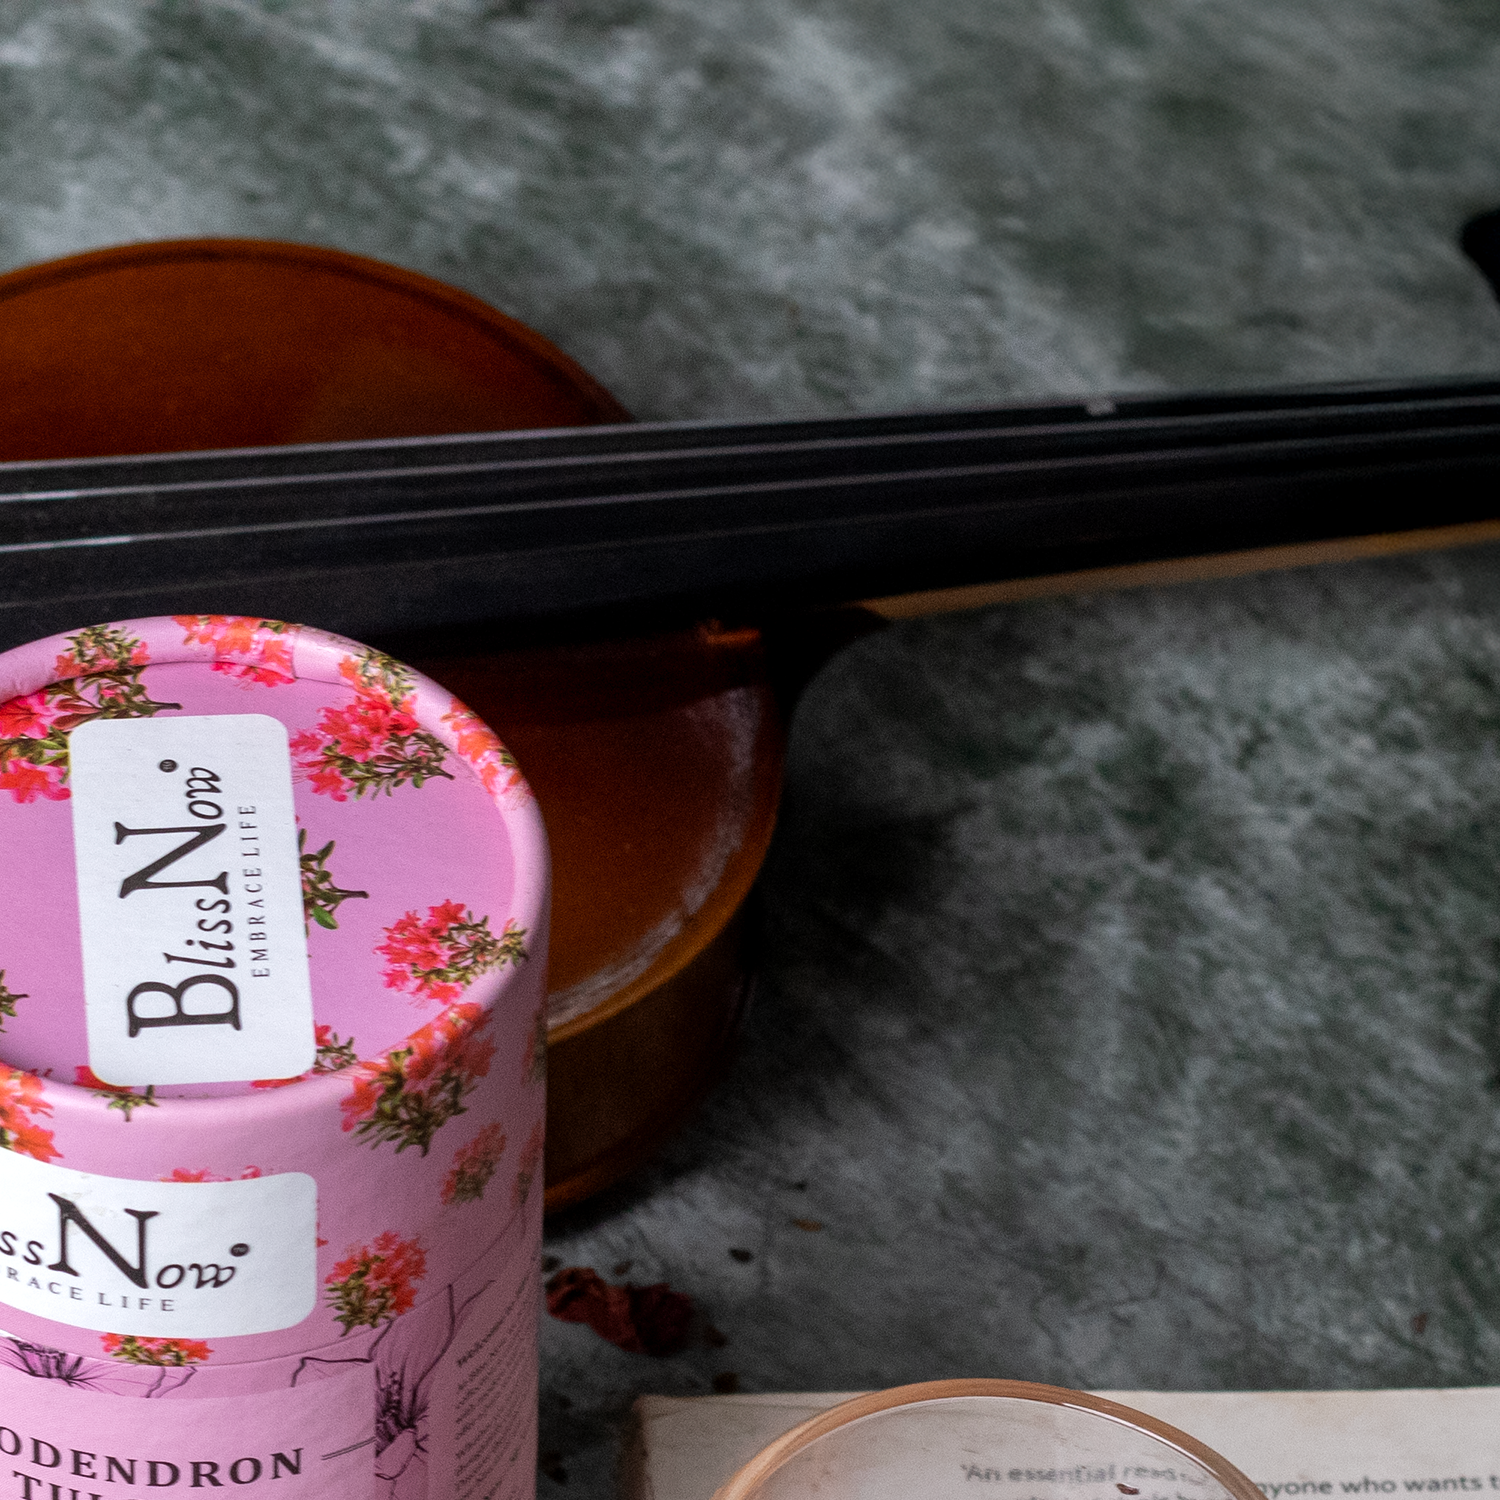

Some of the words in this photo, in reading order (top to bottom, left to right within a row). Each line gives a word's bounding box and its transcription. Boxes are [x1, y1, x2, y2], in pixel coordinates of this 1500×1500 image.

[237, 804, 261, 858] LIFE
[242, 866, 270, 978] EMBRACE
[97, 1291, 176, 1313] LIFE
[1341, 1475, 1397, 1495] who
[1403, 1475, 1483, 1493] wants
